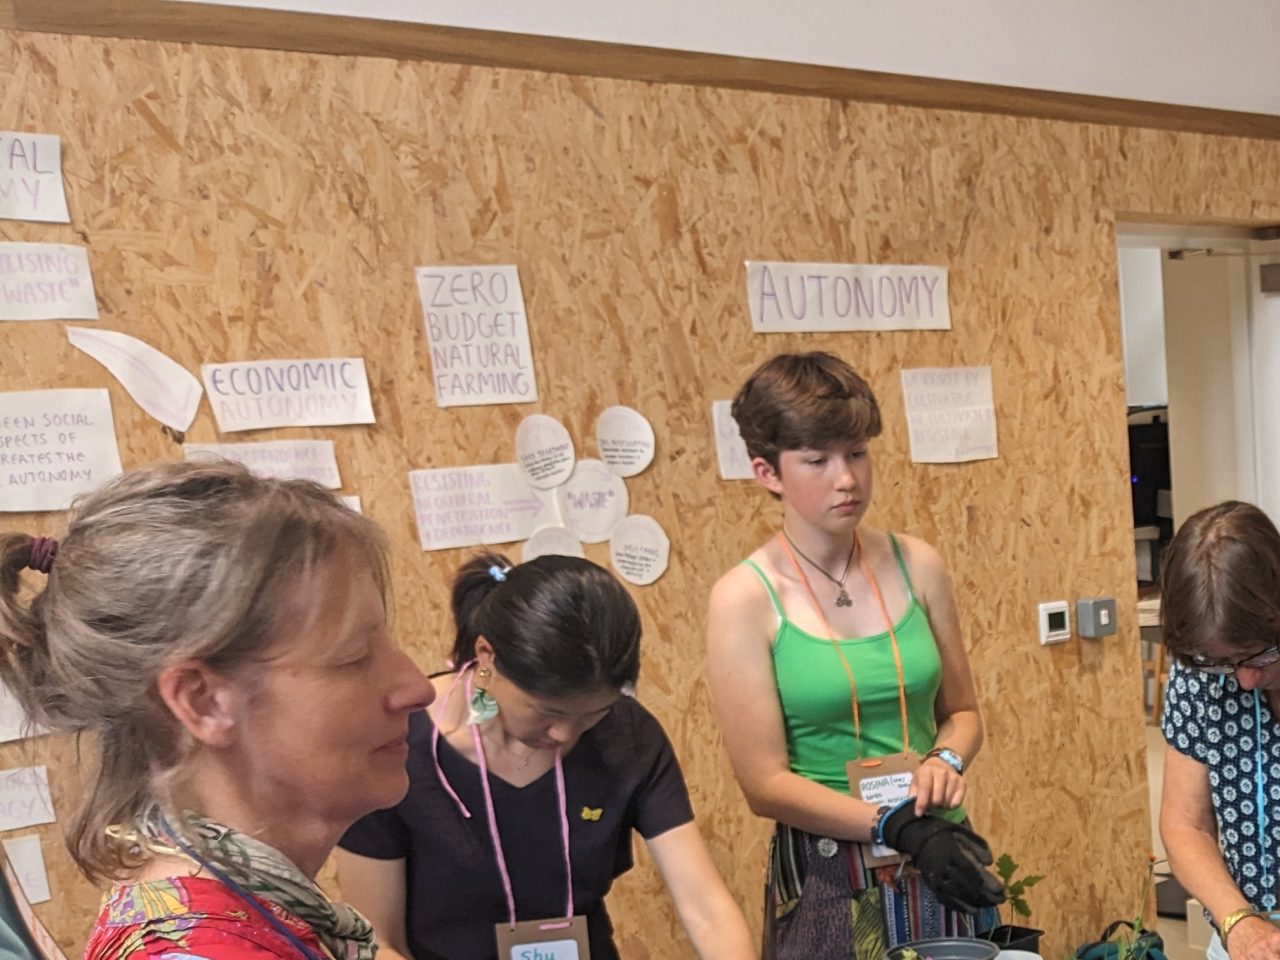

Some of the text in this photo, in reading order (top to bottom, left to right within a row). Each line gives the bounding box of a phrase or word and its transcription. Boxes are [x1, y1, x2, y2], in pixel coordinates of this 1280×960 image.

[0, 137, 55, 174] AL
[422, 271, 509, 308] ZERO
[758, 264, 940, 323] AUTONOMY
[428, 311, 521, 343] BUDGET
[433, 343, 527, 370] NATURAL
[211, 361, 357, 396] ECONOMIC
[438, 371, 531, 399] FARMING
[42, 412, 95, 428] SOCIAL
[220, 392, 358, 421] AUTONOMY
[57, 430, 77, 445] OF
[8, 467, 92, 487] AUTONOMY
